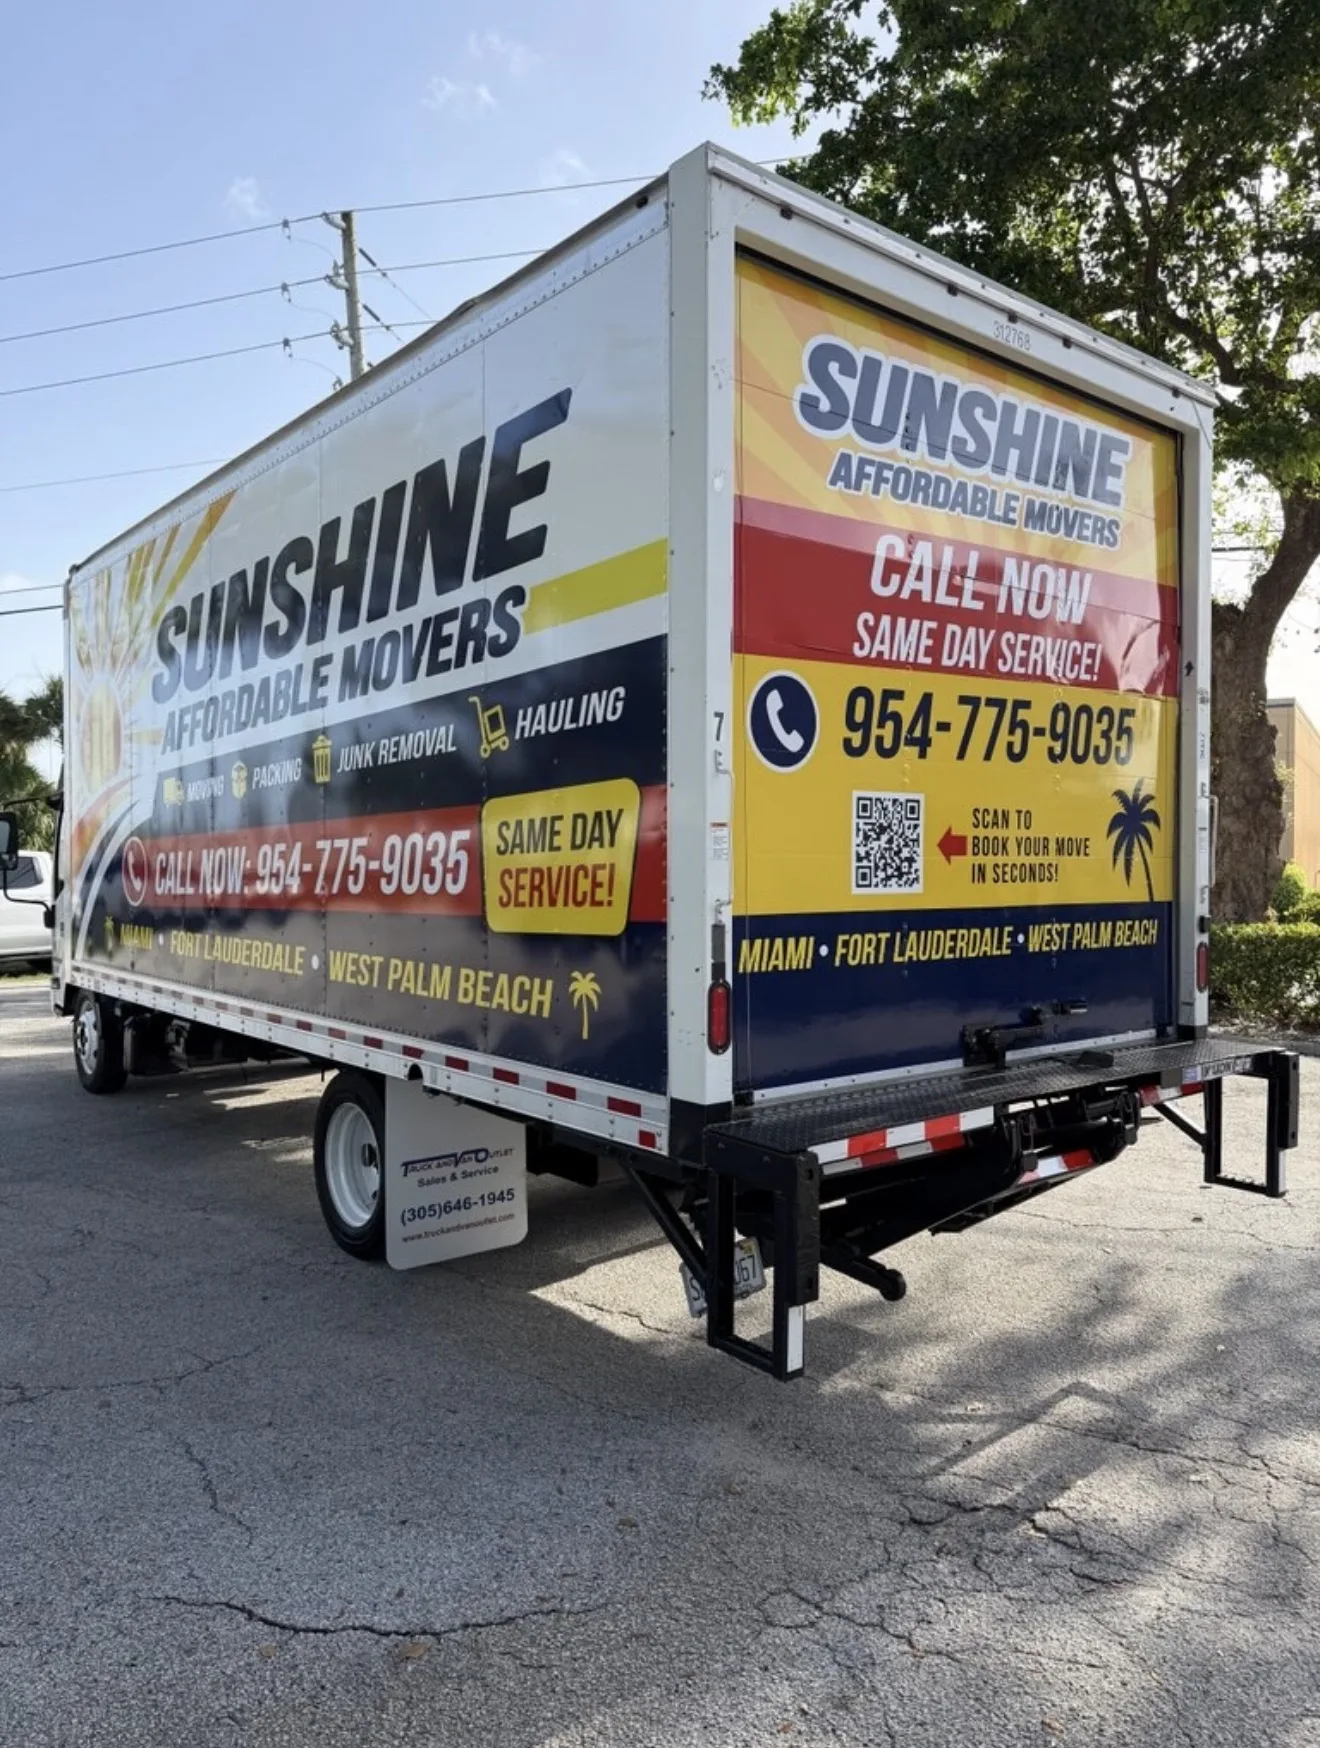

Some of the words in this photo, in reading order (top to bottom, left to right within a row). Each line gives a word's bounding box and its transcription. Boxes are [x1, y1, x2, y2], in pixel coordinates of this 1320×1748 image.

[993, 320, 1031, 350] 312768
[797, 341, 1131, 507] SUNSHINE
[828, 451, 1021, 526] AFFORDABLE
[1023, 498, 1121, 548] MOVERS
[152, 387, 572, 703] SUNSHINE
[870, 534, 985, 611] CALL
[996, 556, 1093, 625] NOW
[161, 653, 334, 756] AFFORDABLE
[338, 584, 527, 699] MOVERS
[852, 611, 938, 666] SAME
[941, 623, 996, 671] DAY
[997, 630, 1103, 682] SERVICE!
[514, 686, 626, 740] HAULING
[713, 711, 724, 742] 7
[842, 685, 1136, 766] 954-775-9035
[336, 742, 375, 773] JUNK
[377, 724, 457, 765] REMOVAL
[252, 758, 302, 789] PACKING
[496, 815, 565, 855] SAME
[570, 808, 625, 851] DAY
[971, 807, 1010, 831] SCAN
[1014, 808, 1033, 831] TO
[154, 850, 195, 896] CALL
[199, 846, 251, 895] NOW:
[256, 829, 473, 896] 954-775-9035
[971, 835, 1011, 857] BOOK
[1014, 836, 1051, 857] YOUR
[1055, 836, 1091, 858] MOVE
[498, 863, 616, 908] SERVICE!
[971, 864, 987, 884] IN
[991, 862, 1059, 884] SECONDS!
[170, 929, 203, 955] FORT
[204, 932, 307, 976] LAUDERDALE
[738, 936, 815, 974] MIAMI
[835, 931, 892, 968] FORT
[893, 926, 1013, 964] LAUDERDALE
[1027, 924, 1073, 954] WEST
[1073, 921, 1113, 951] PALM
[1114, 918, 1158, 947] BEACH
[329, 949, 384, 987] WEST
[387, 958, 452, 1001] PALM
[458, 967, 554, 1018] BEACH
[417, 1175, 447, 1188] Sales
[449, 1172, 458, 1182] &
[461, 1165, 499, 1180] Service
[400, 1187, 516, 1227] (305)646-1945
